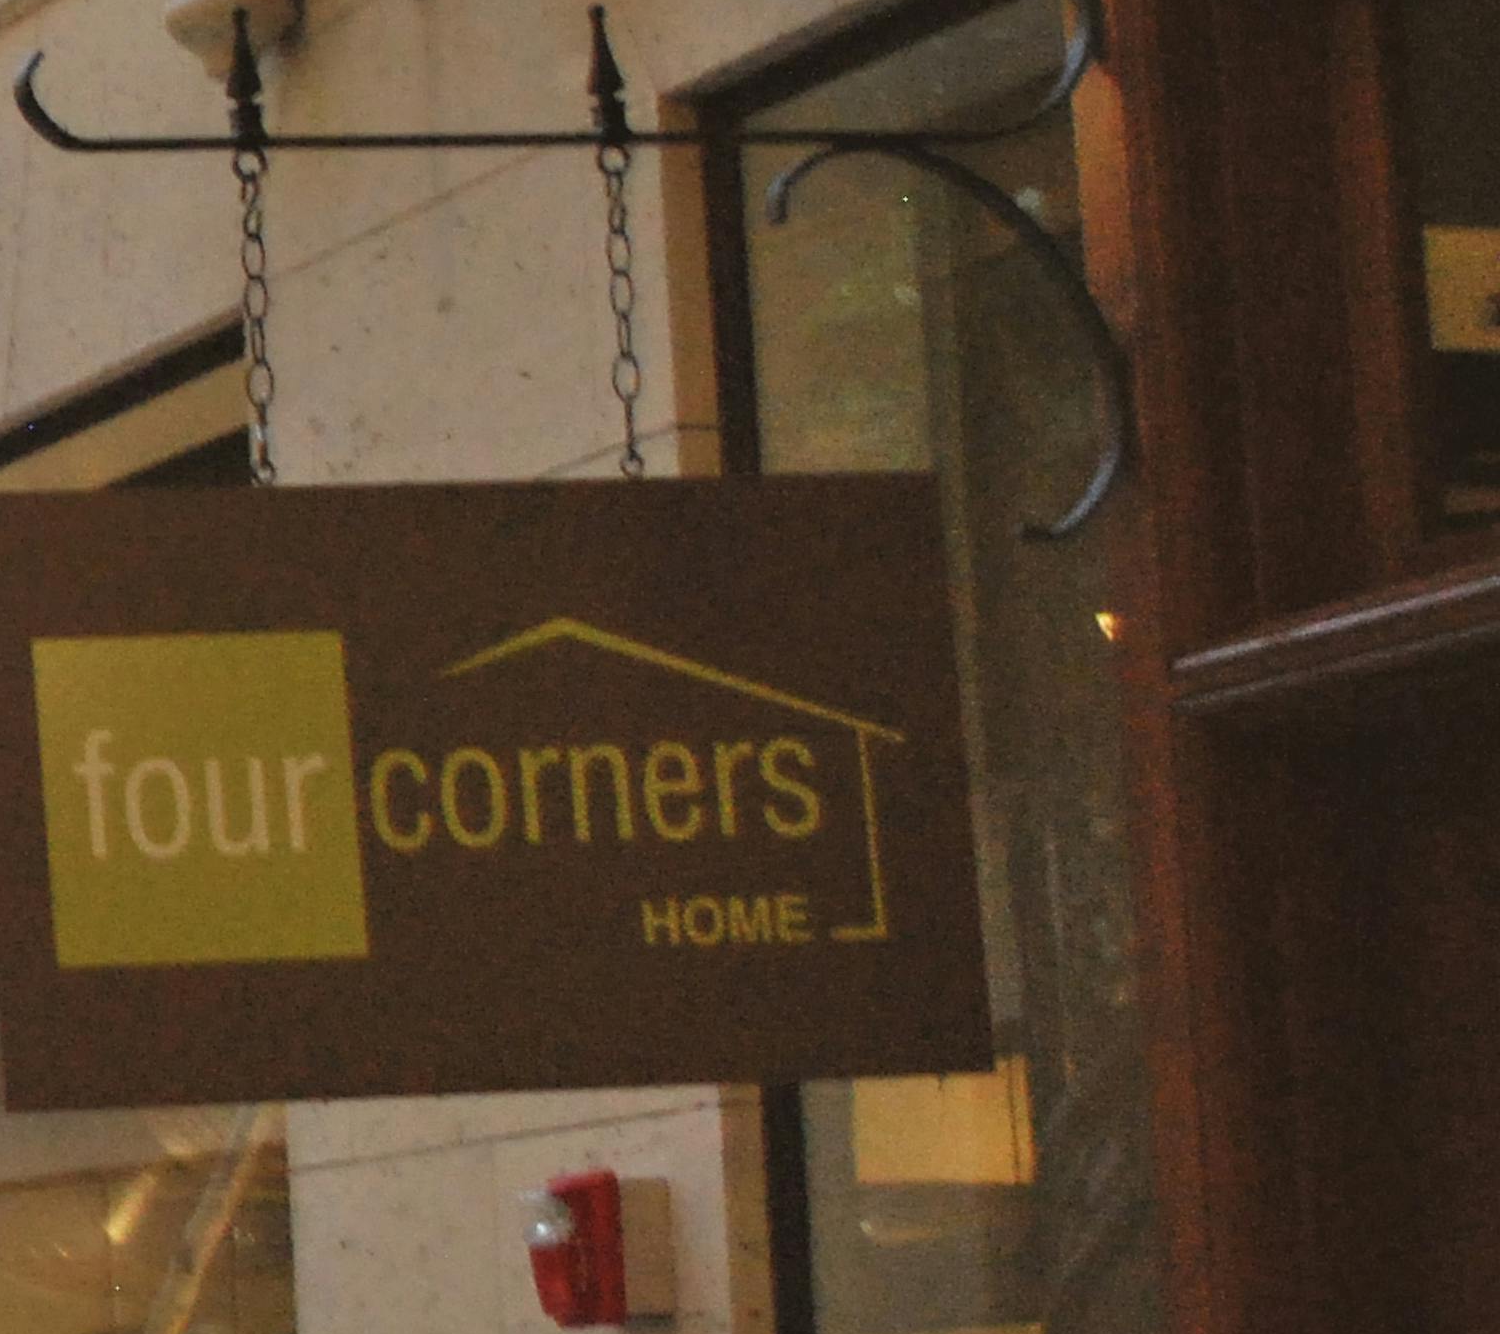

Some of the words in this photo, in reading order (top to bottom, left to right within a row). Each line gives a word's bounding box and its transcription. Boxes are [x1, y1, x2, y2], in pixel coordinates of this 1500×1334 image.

[73, 728, 326, 861] four
[369, 736, 821, 851] corners
[640, 894, 814, 947] HOME
